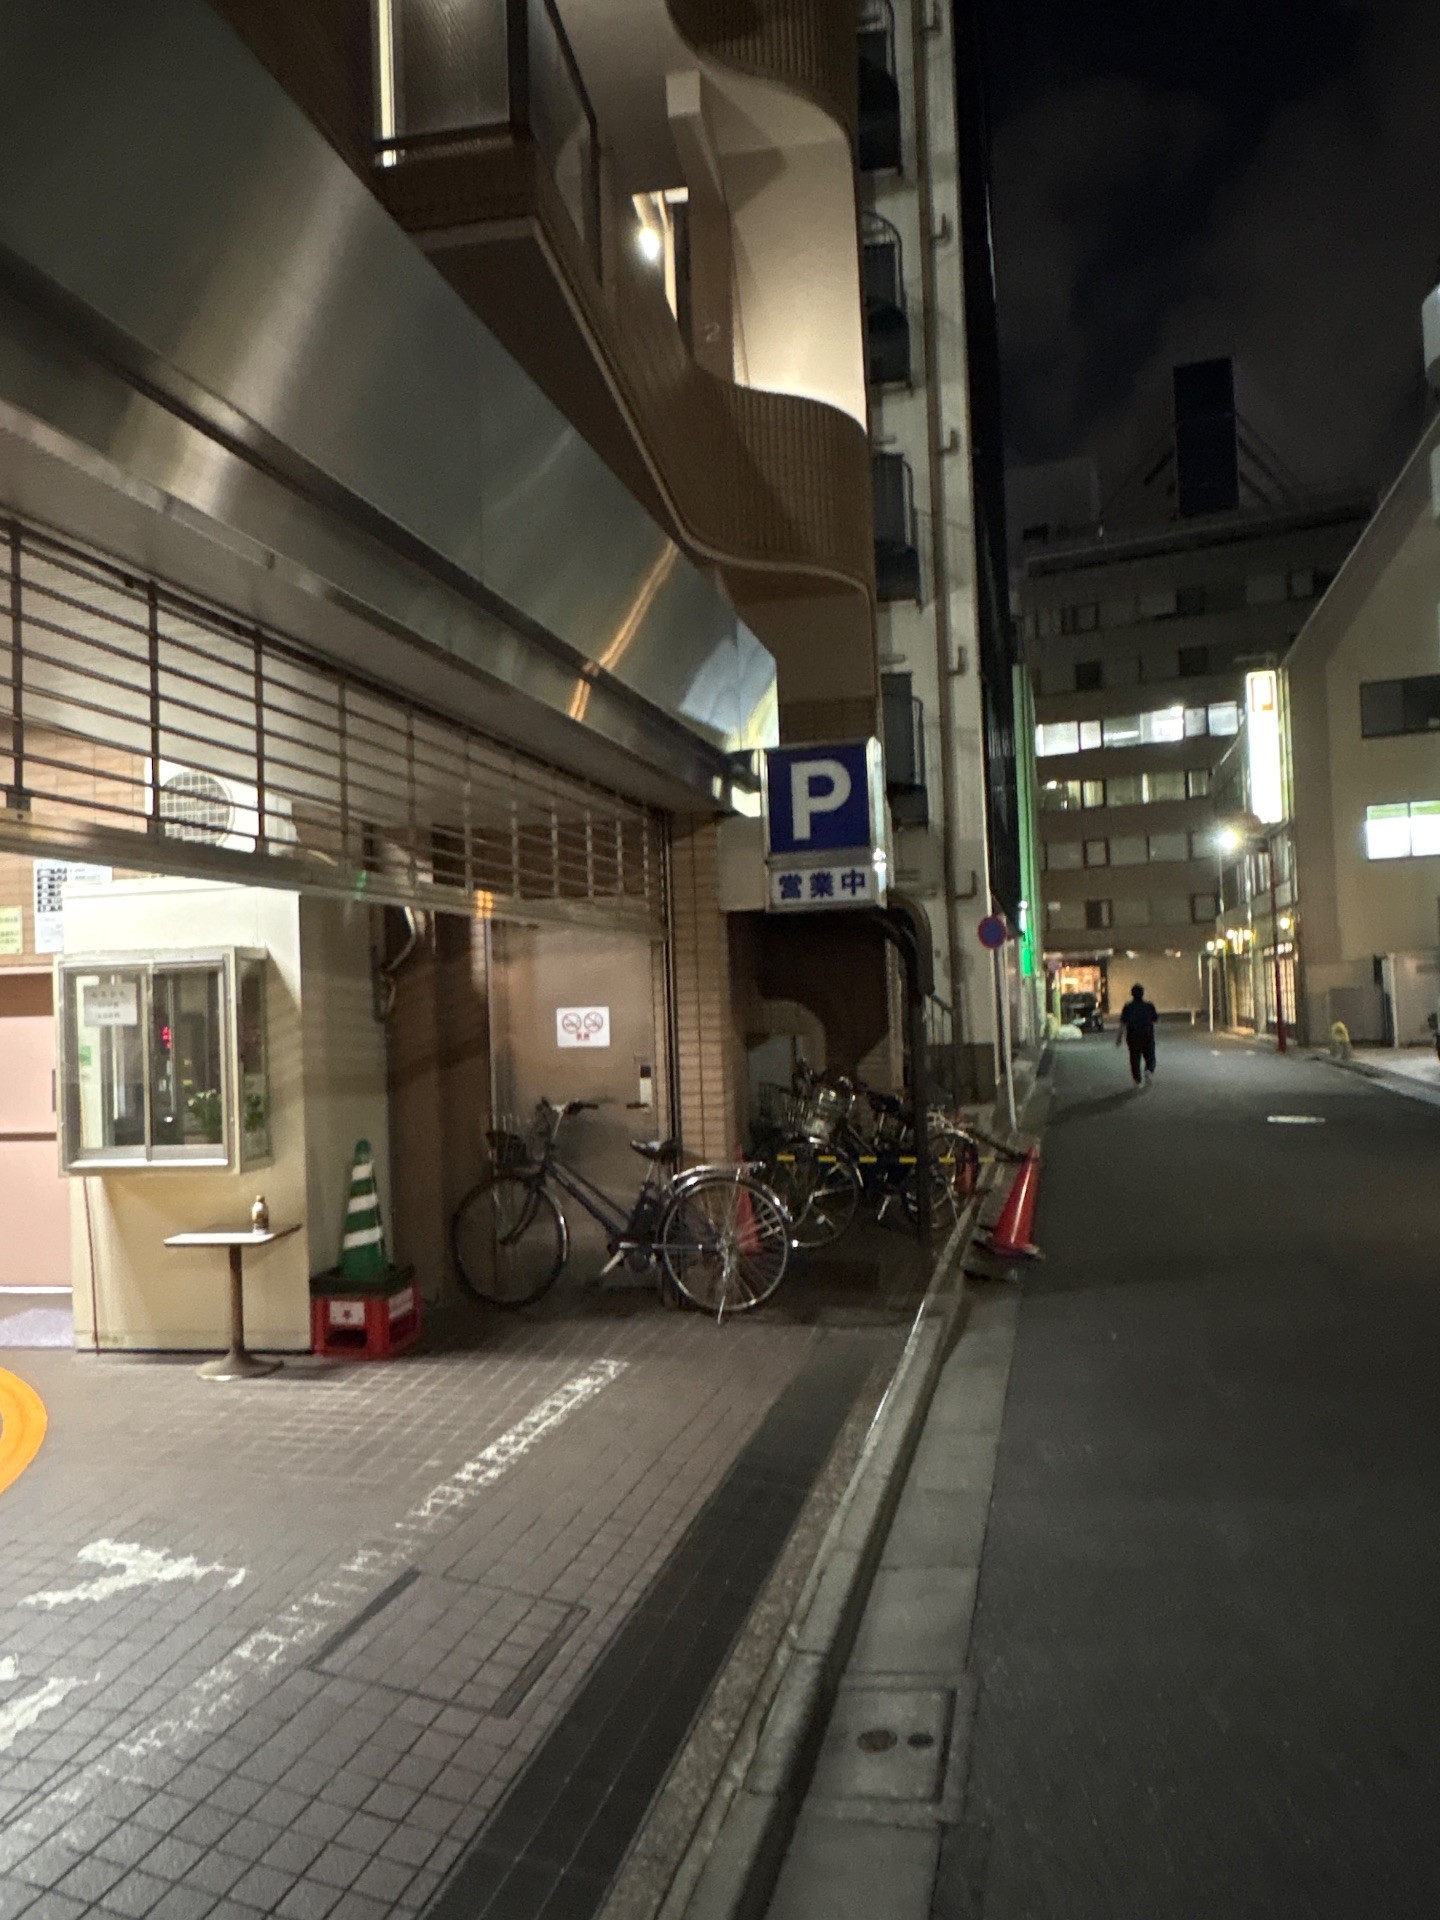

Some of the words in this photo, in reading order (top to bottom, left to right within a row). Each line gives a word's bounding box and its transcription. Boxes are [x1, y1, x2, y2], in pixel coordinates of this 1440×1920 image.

[790, 759, 852, 841] P
[779, 868, 866, 899] 営業中
